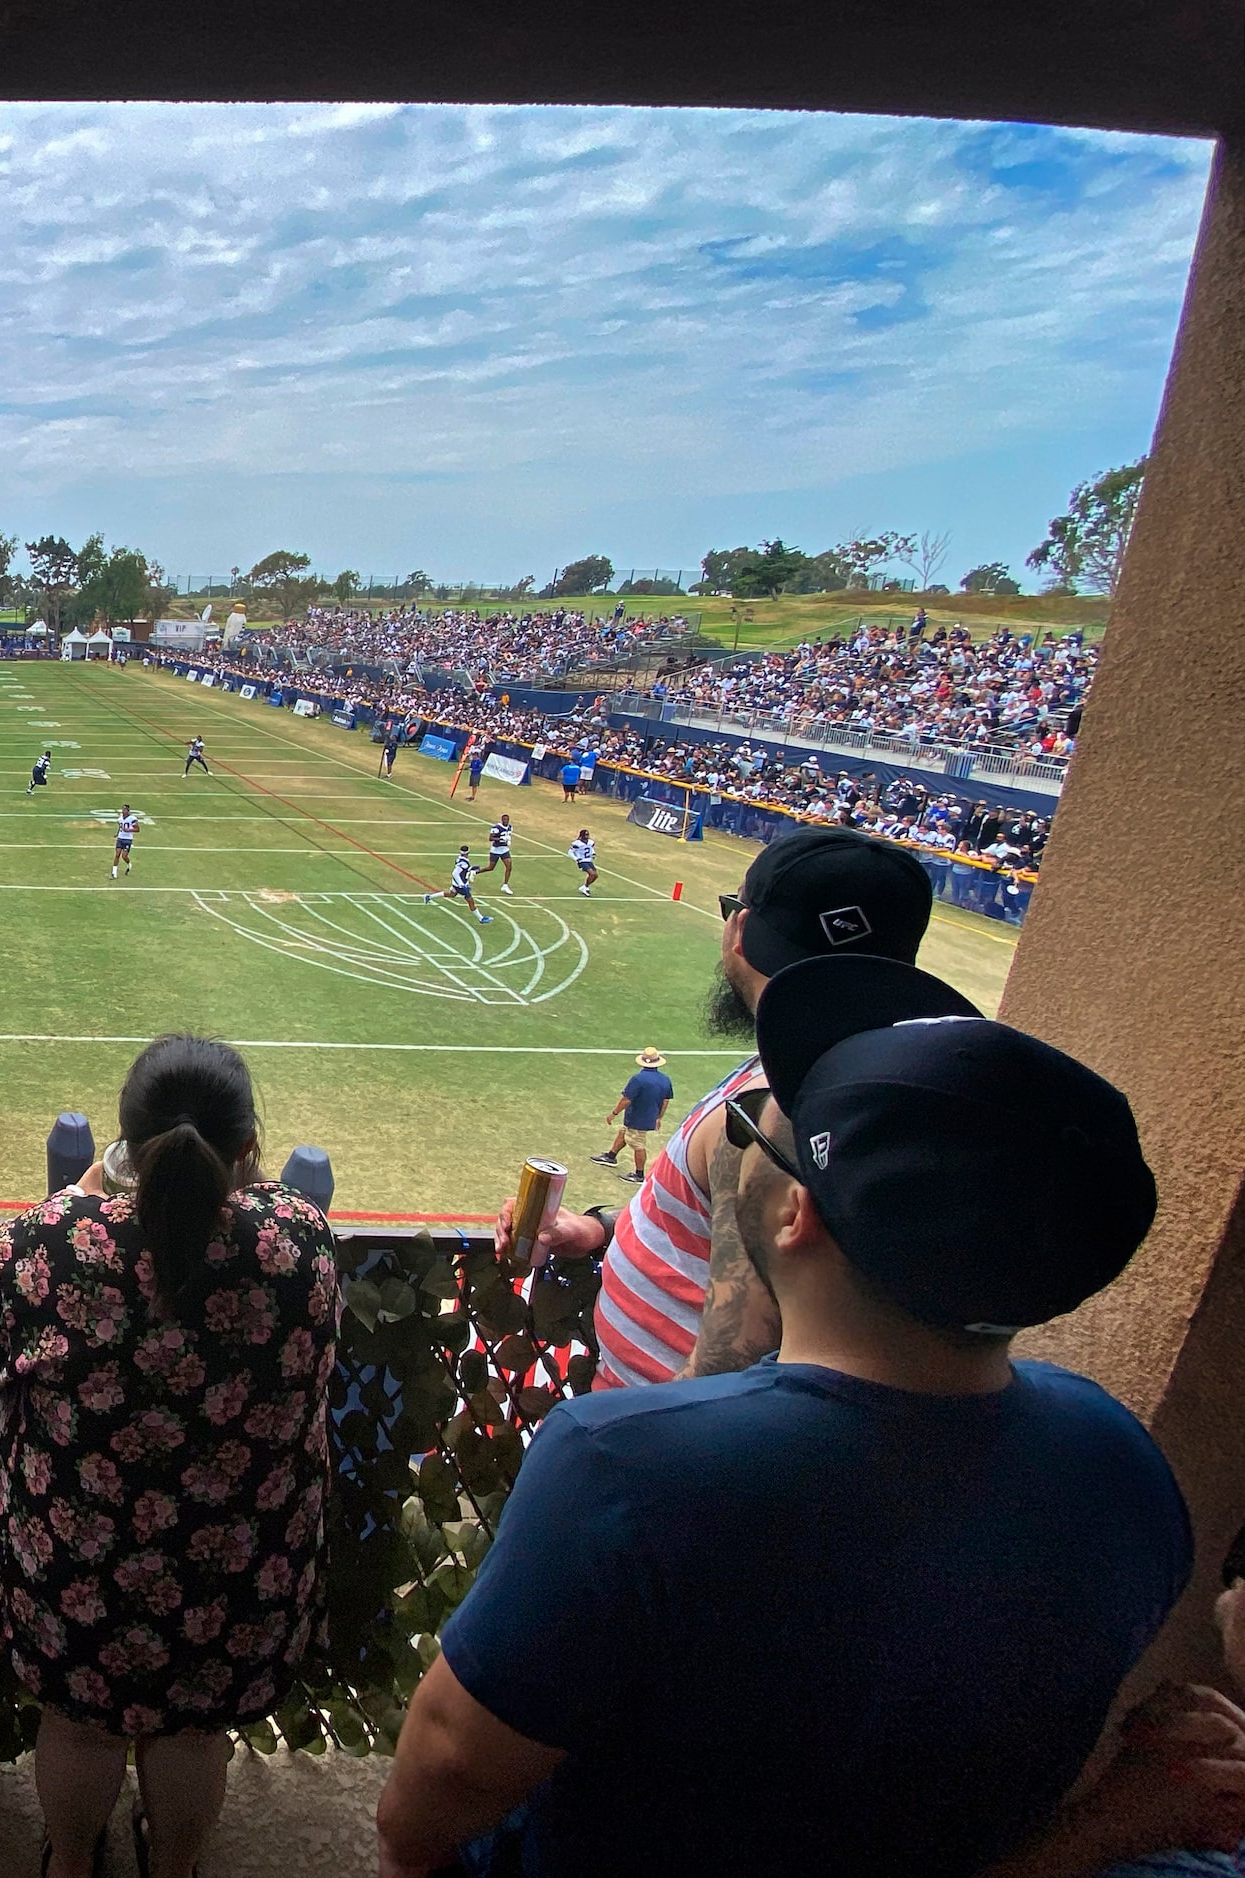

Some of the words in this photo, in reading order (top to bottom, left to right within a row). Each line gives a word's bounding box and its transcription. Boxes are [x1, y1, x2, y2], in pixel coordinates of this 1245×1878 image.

[646, 807, 678, 831] Lite
[584, 847, 590, 858] 2
[832, 918, 859, 932] UFC
